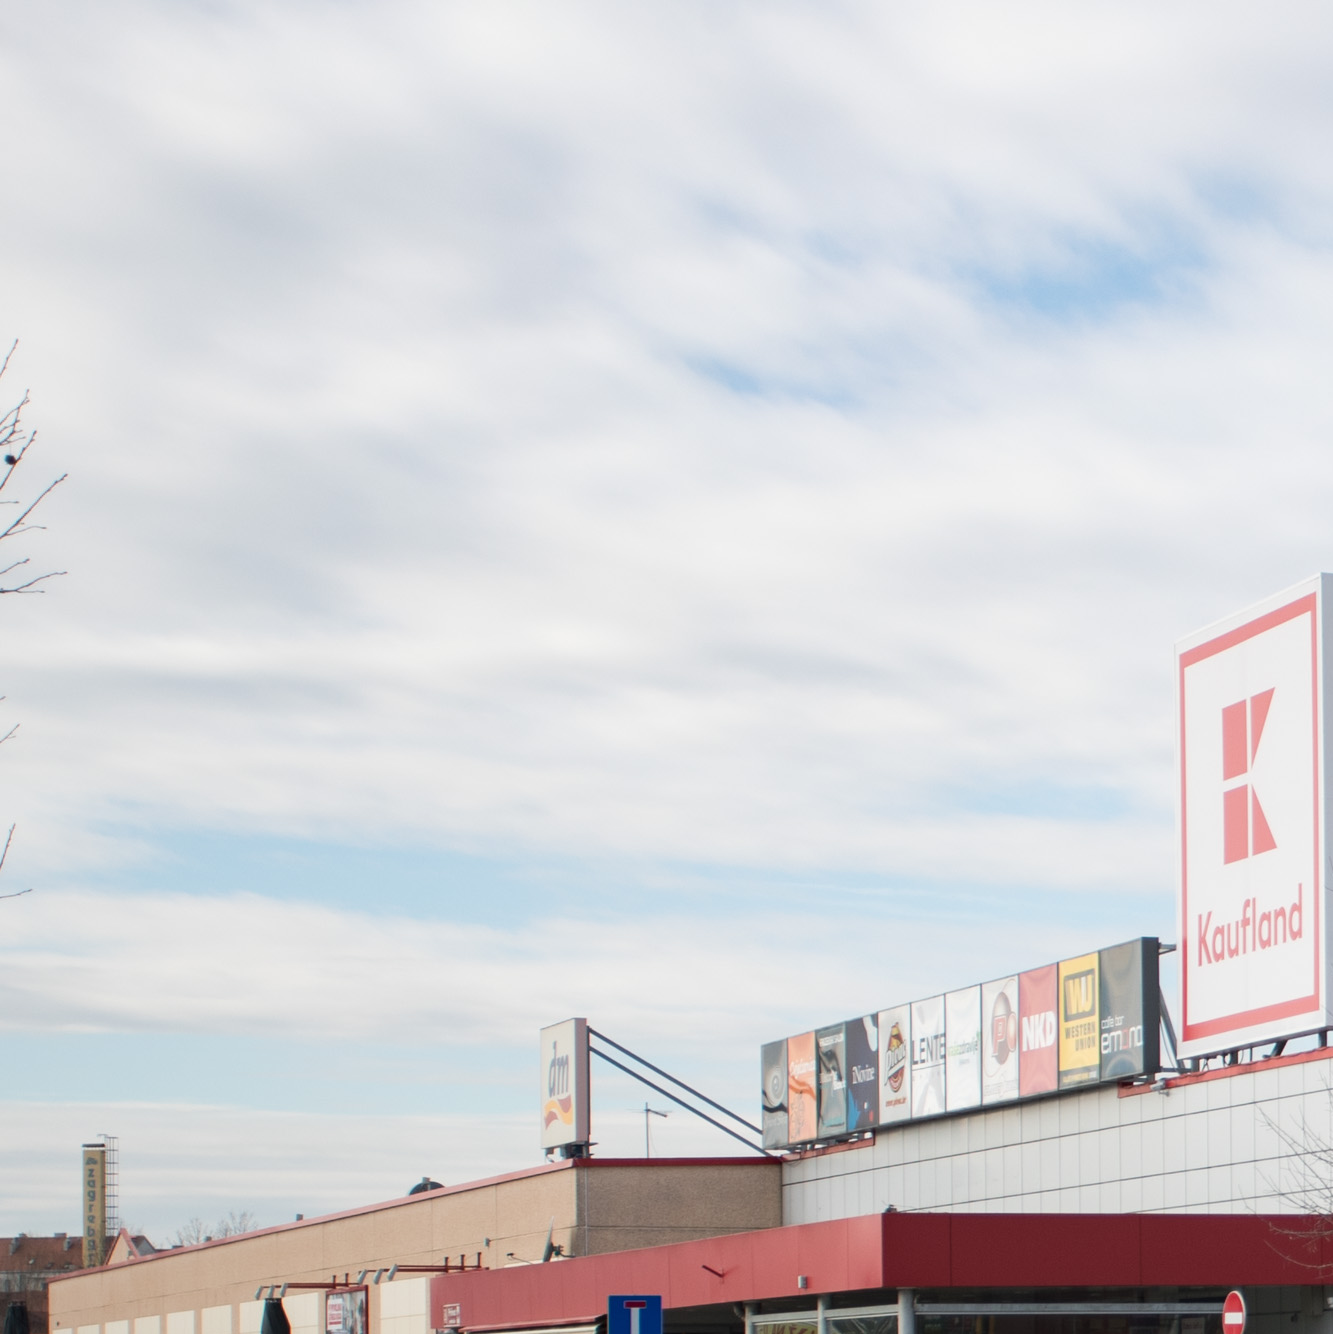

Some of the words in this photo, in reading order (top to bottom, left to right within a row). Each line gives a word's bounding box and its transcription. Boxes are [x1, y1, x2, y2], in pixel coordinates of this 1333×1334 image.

[1197, 883, 1304, 967] Kaufland
[1022, 1011, 1056, 1052] NKD
[1065, 1021, 1096, 1039] WESTERN
[1075, 1036, 1096, 1052] UNION
[912, 1032, 945, 1065] LENTE
[548, 1040, 569, 1098] dm
[852, 1064, 875, 1084] iNovine
